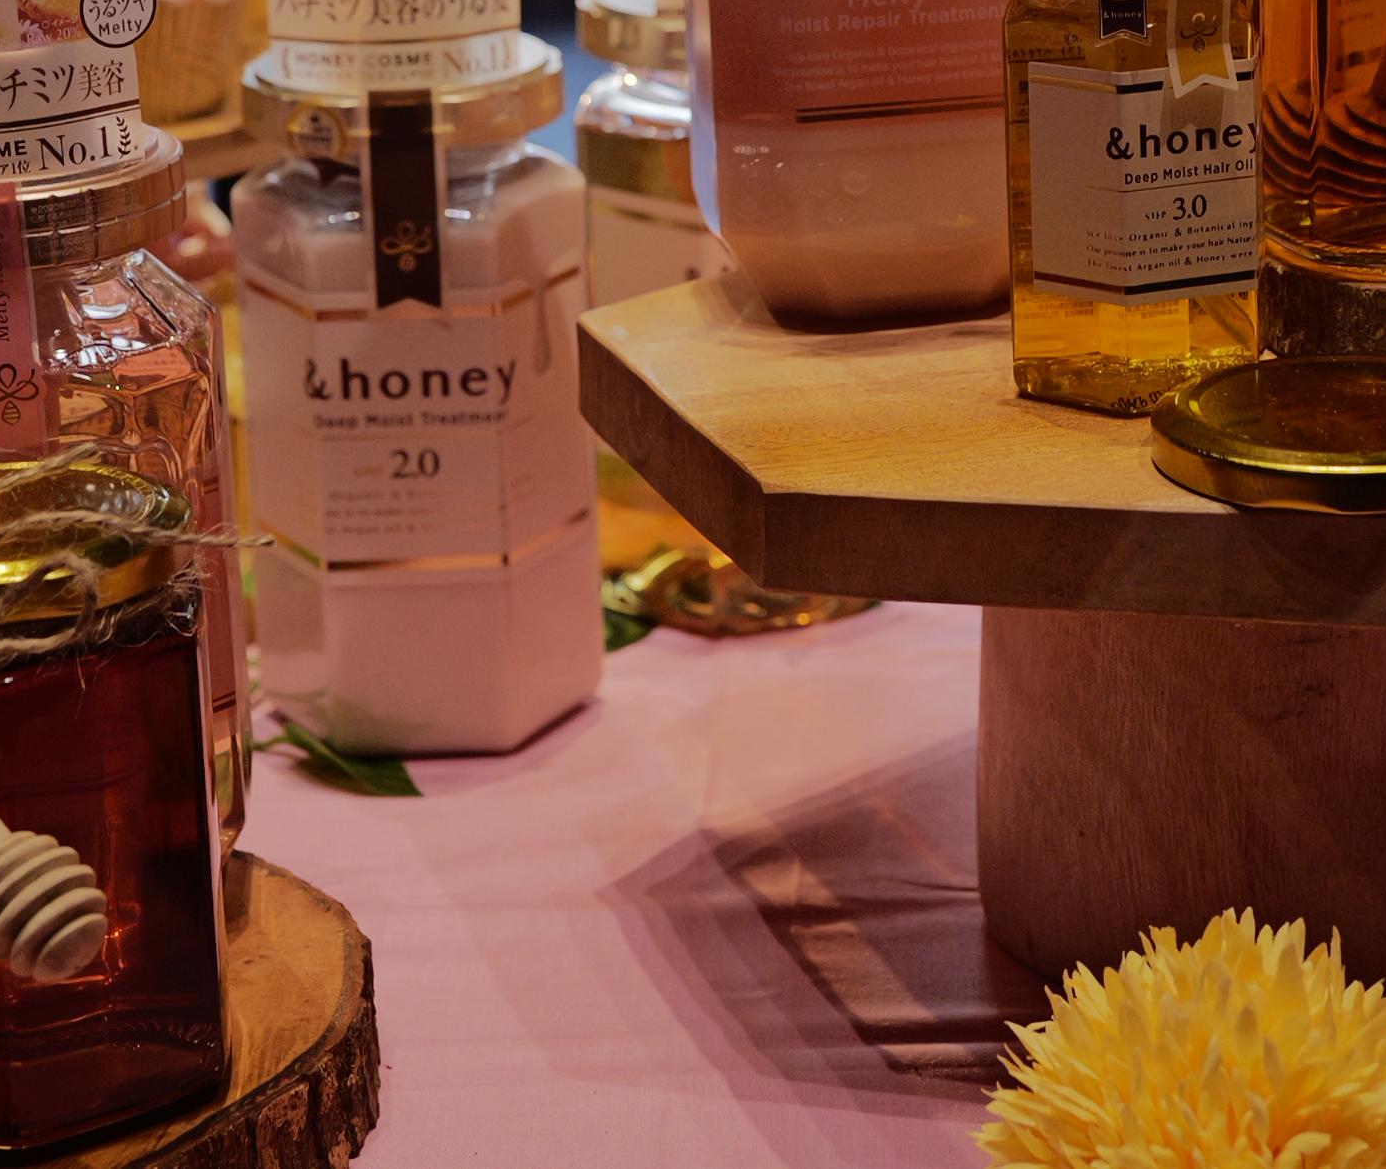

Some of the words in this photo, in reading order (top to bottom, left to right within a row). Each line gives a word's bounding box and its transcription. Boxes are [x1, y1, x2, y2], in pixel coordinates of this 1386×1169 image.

[98, 17, 143, 38] Melty
[838, 11, 902, 31] Repair
[36, 126, 111, 172] No.1
[1124, 171, 1158, 185] Deep
[1163, 165, 1199, 180] Moist
[1203, 161, 1230, 174] Hair
[1235, 159, 1253, 171] Oil
[1172, 194, 1207, 221] 3.0
[1173, 227, 1182, 238] &
[1149, 246, 1159, 255] to
[1160, 243, 1184, 253] make
[1187, 240, 1206, 250] your
[1208, 238, 1225, 247] hair
[1136, 261, 1165, 272] Argan
[1184, 256, 1193, 266] &
[1196, 254, 1226, 264] Honey
[303, 358, 517, 405] &honey
